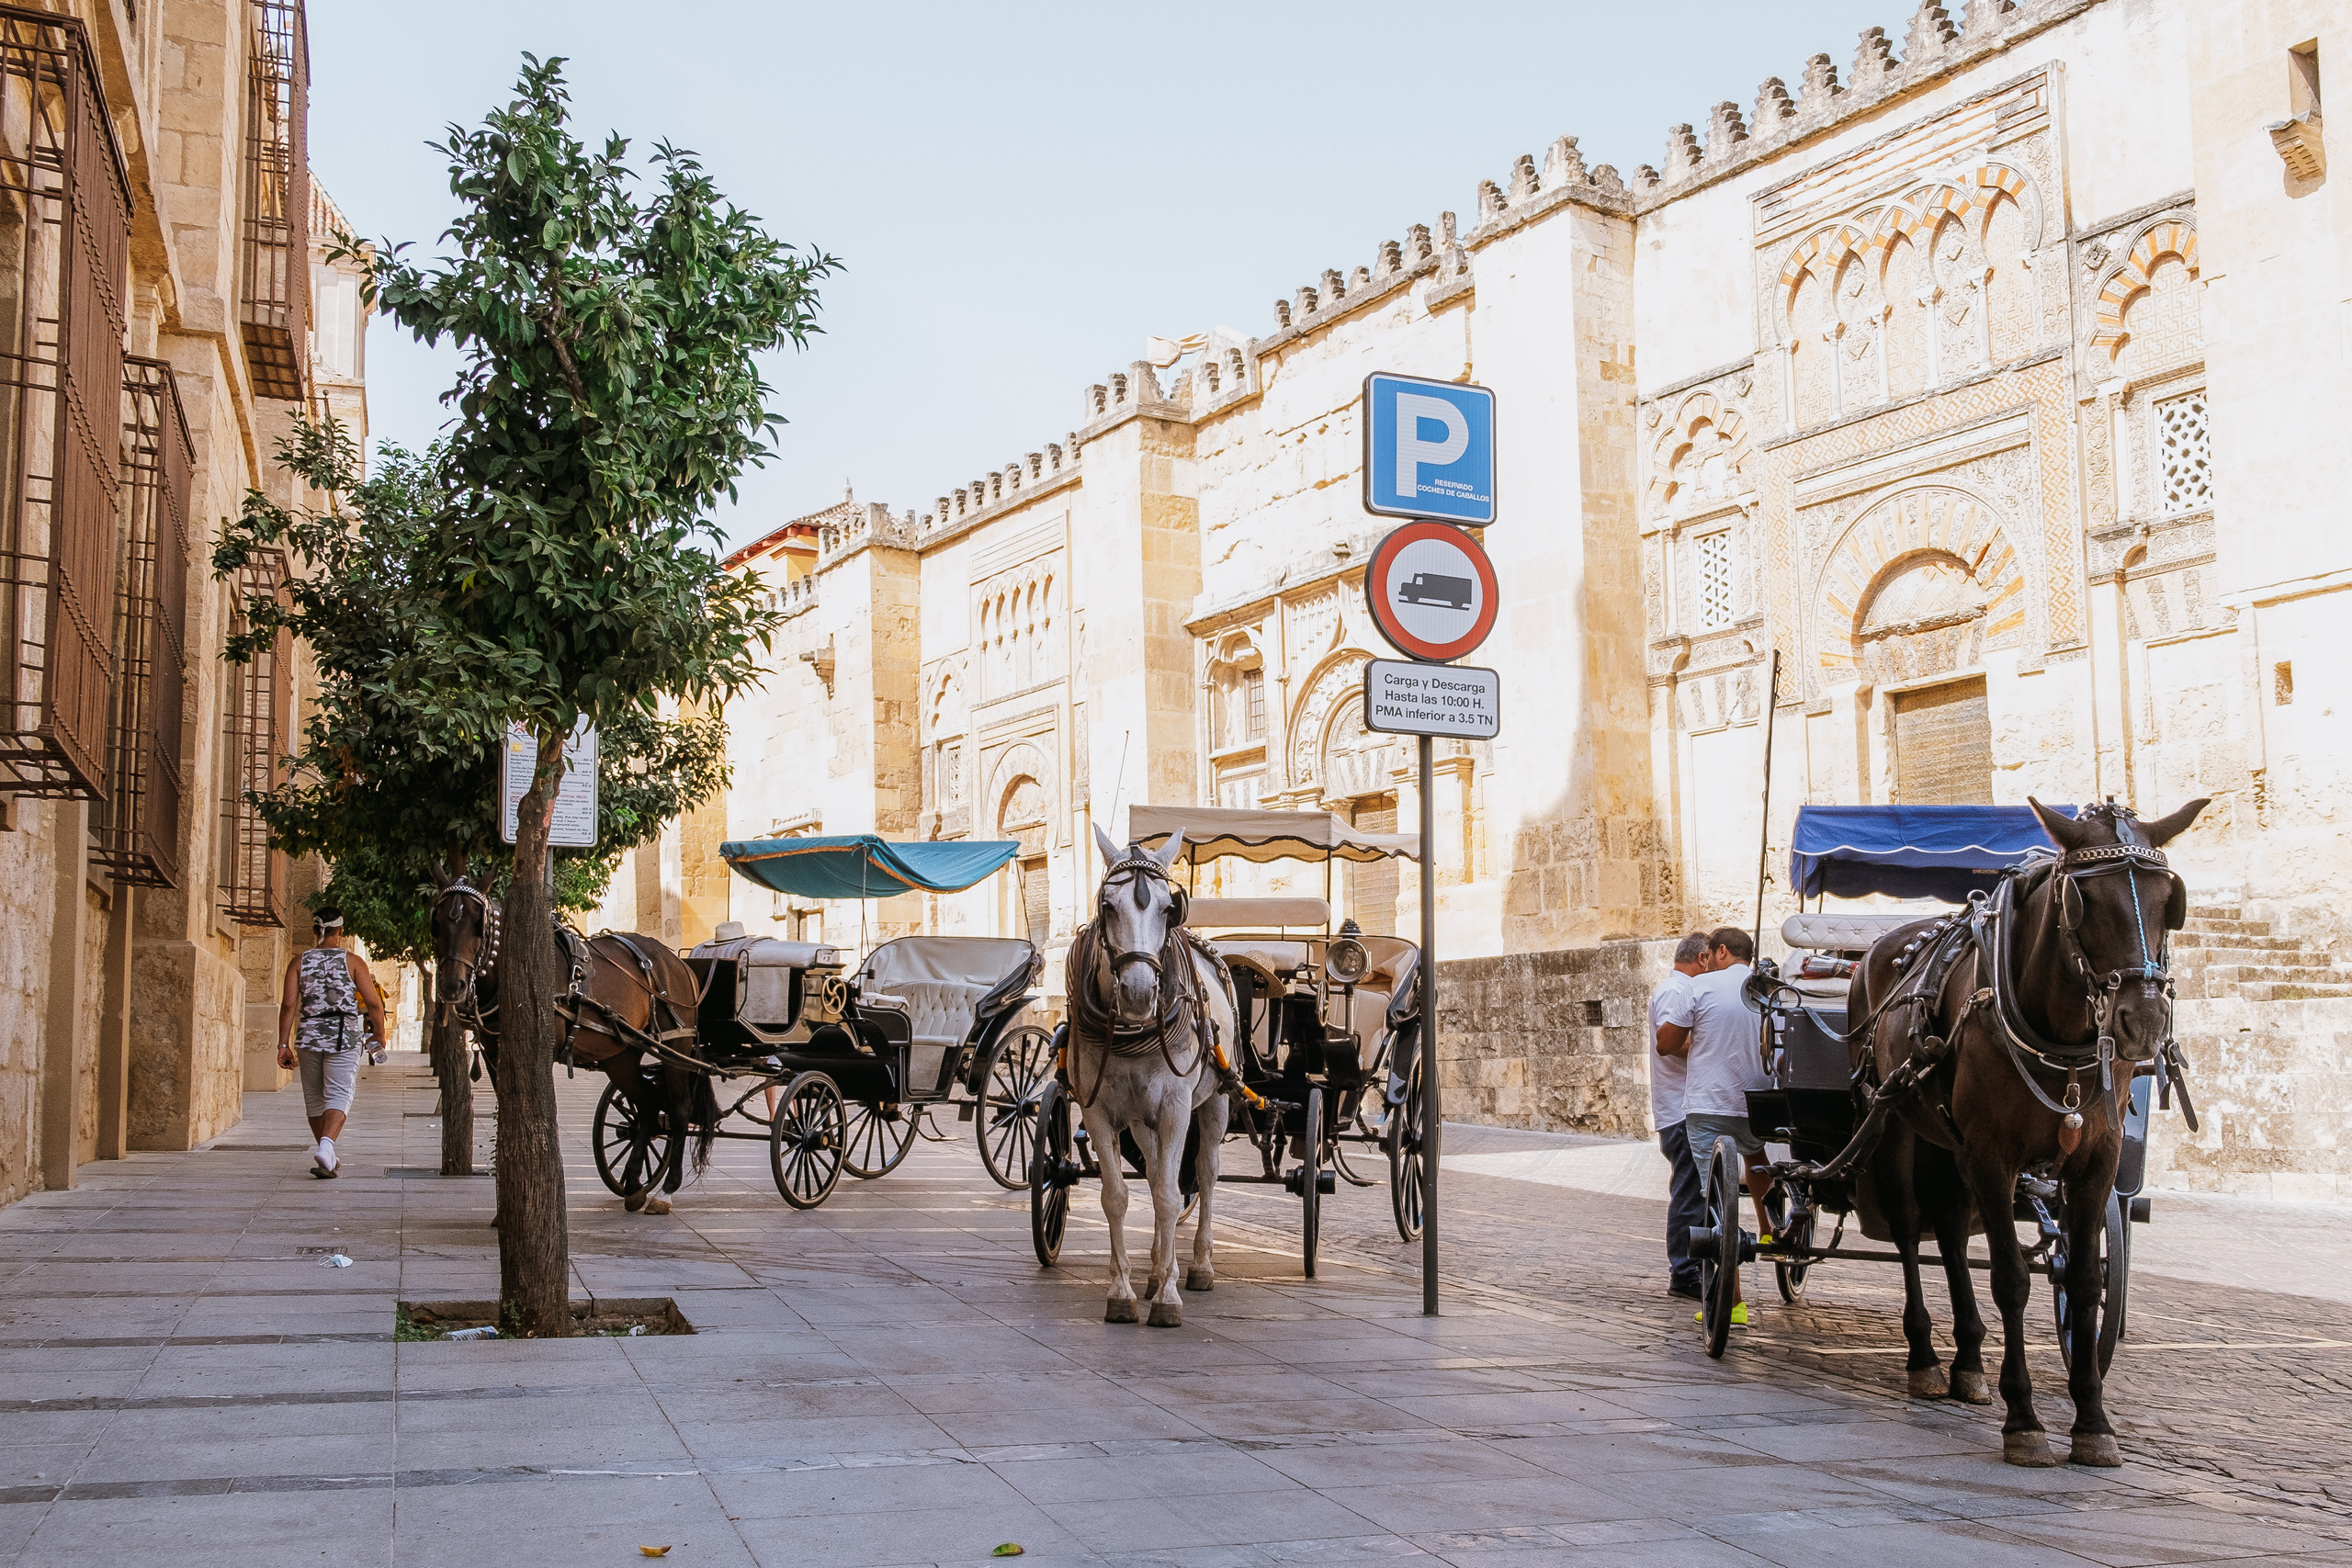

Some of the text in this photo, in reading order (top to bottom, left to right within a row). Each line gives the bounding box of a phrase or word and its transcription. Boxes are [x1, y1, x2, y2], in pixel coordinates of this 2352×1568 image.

[1396, 391, 1469, 499] P
[1417, 484, 1490, 502] COCHES DE CABALLOS
[1434, 479, 1474, 491] RESERVADO
[1384, 673, 1486, 695] Carga y Descarga
[1385, 690, 1485, 709] Hasta las 10:00 H.
[1375, 705, 1493, 726] PMA inferior a 3.5 TN
